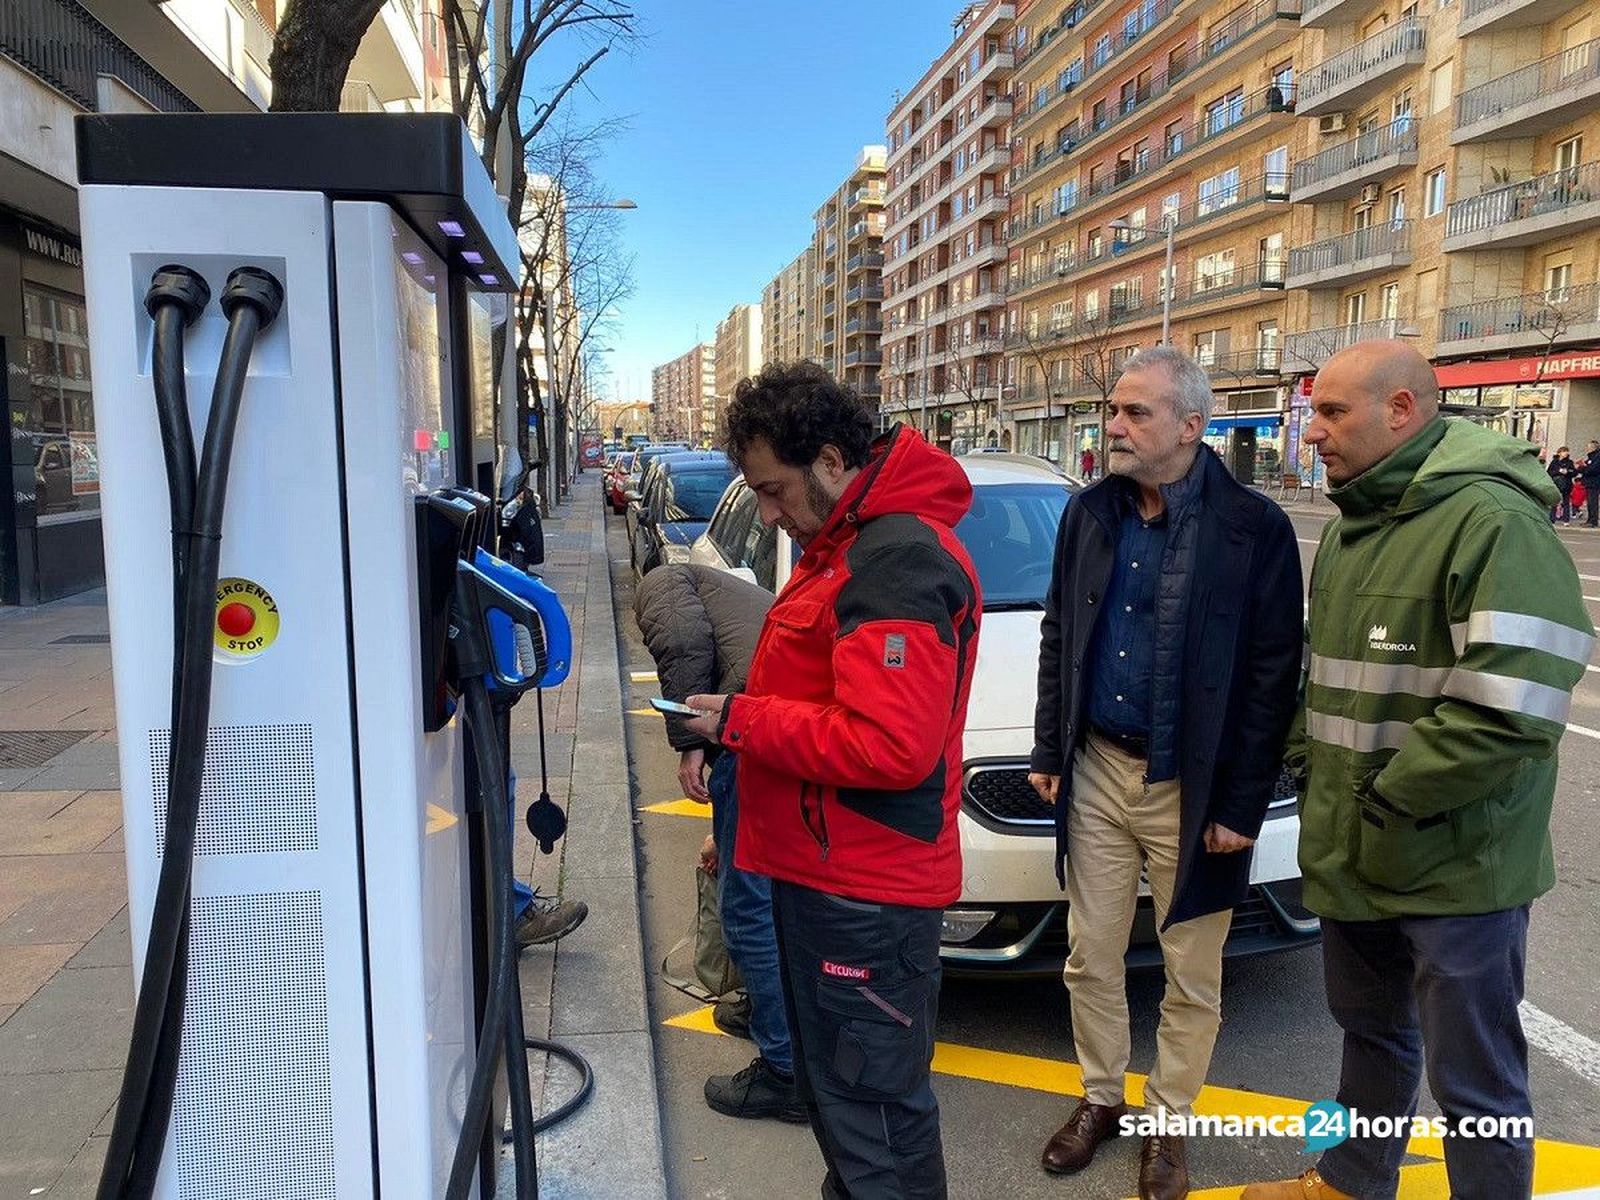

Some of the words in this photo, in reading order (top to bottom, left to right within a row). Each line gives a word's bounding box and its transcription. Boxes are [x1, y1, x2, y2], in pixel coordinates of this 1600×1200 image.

[24, 227, 82, 267] WWW.RO
[1536, 356, 1600, 375] MAPFRE
[214, 582, 278, 614] ERGENCY
[227, 636, 264, 651] STOP
